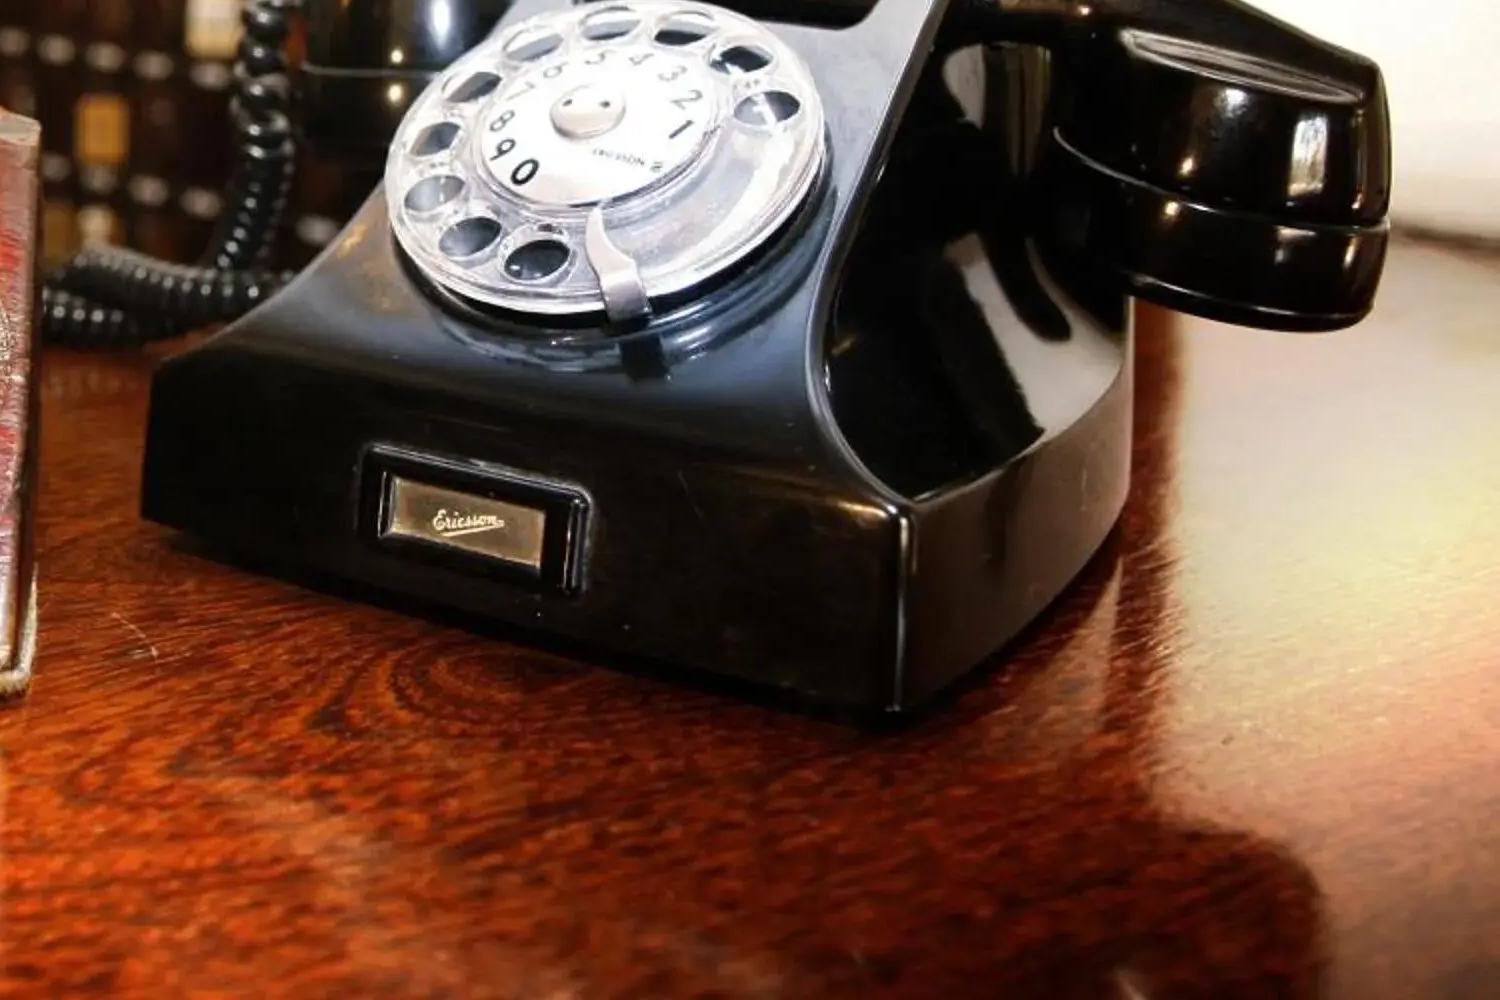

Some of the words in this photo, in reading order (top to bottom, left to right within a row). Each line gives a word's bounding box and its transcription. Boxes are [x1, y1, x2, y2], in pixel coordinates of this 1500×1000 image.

[668, 89, 704, 111] 2
[489, 109, 516, 132] 8
[668, 119, 695, 140] 1
[489, 138, 517, 162] 9
[510, 157, 540, 186] 0
[433, 508, 505, 537] Ericsson
